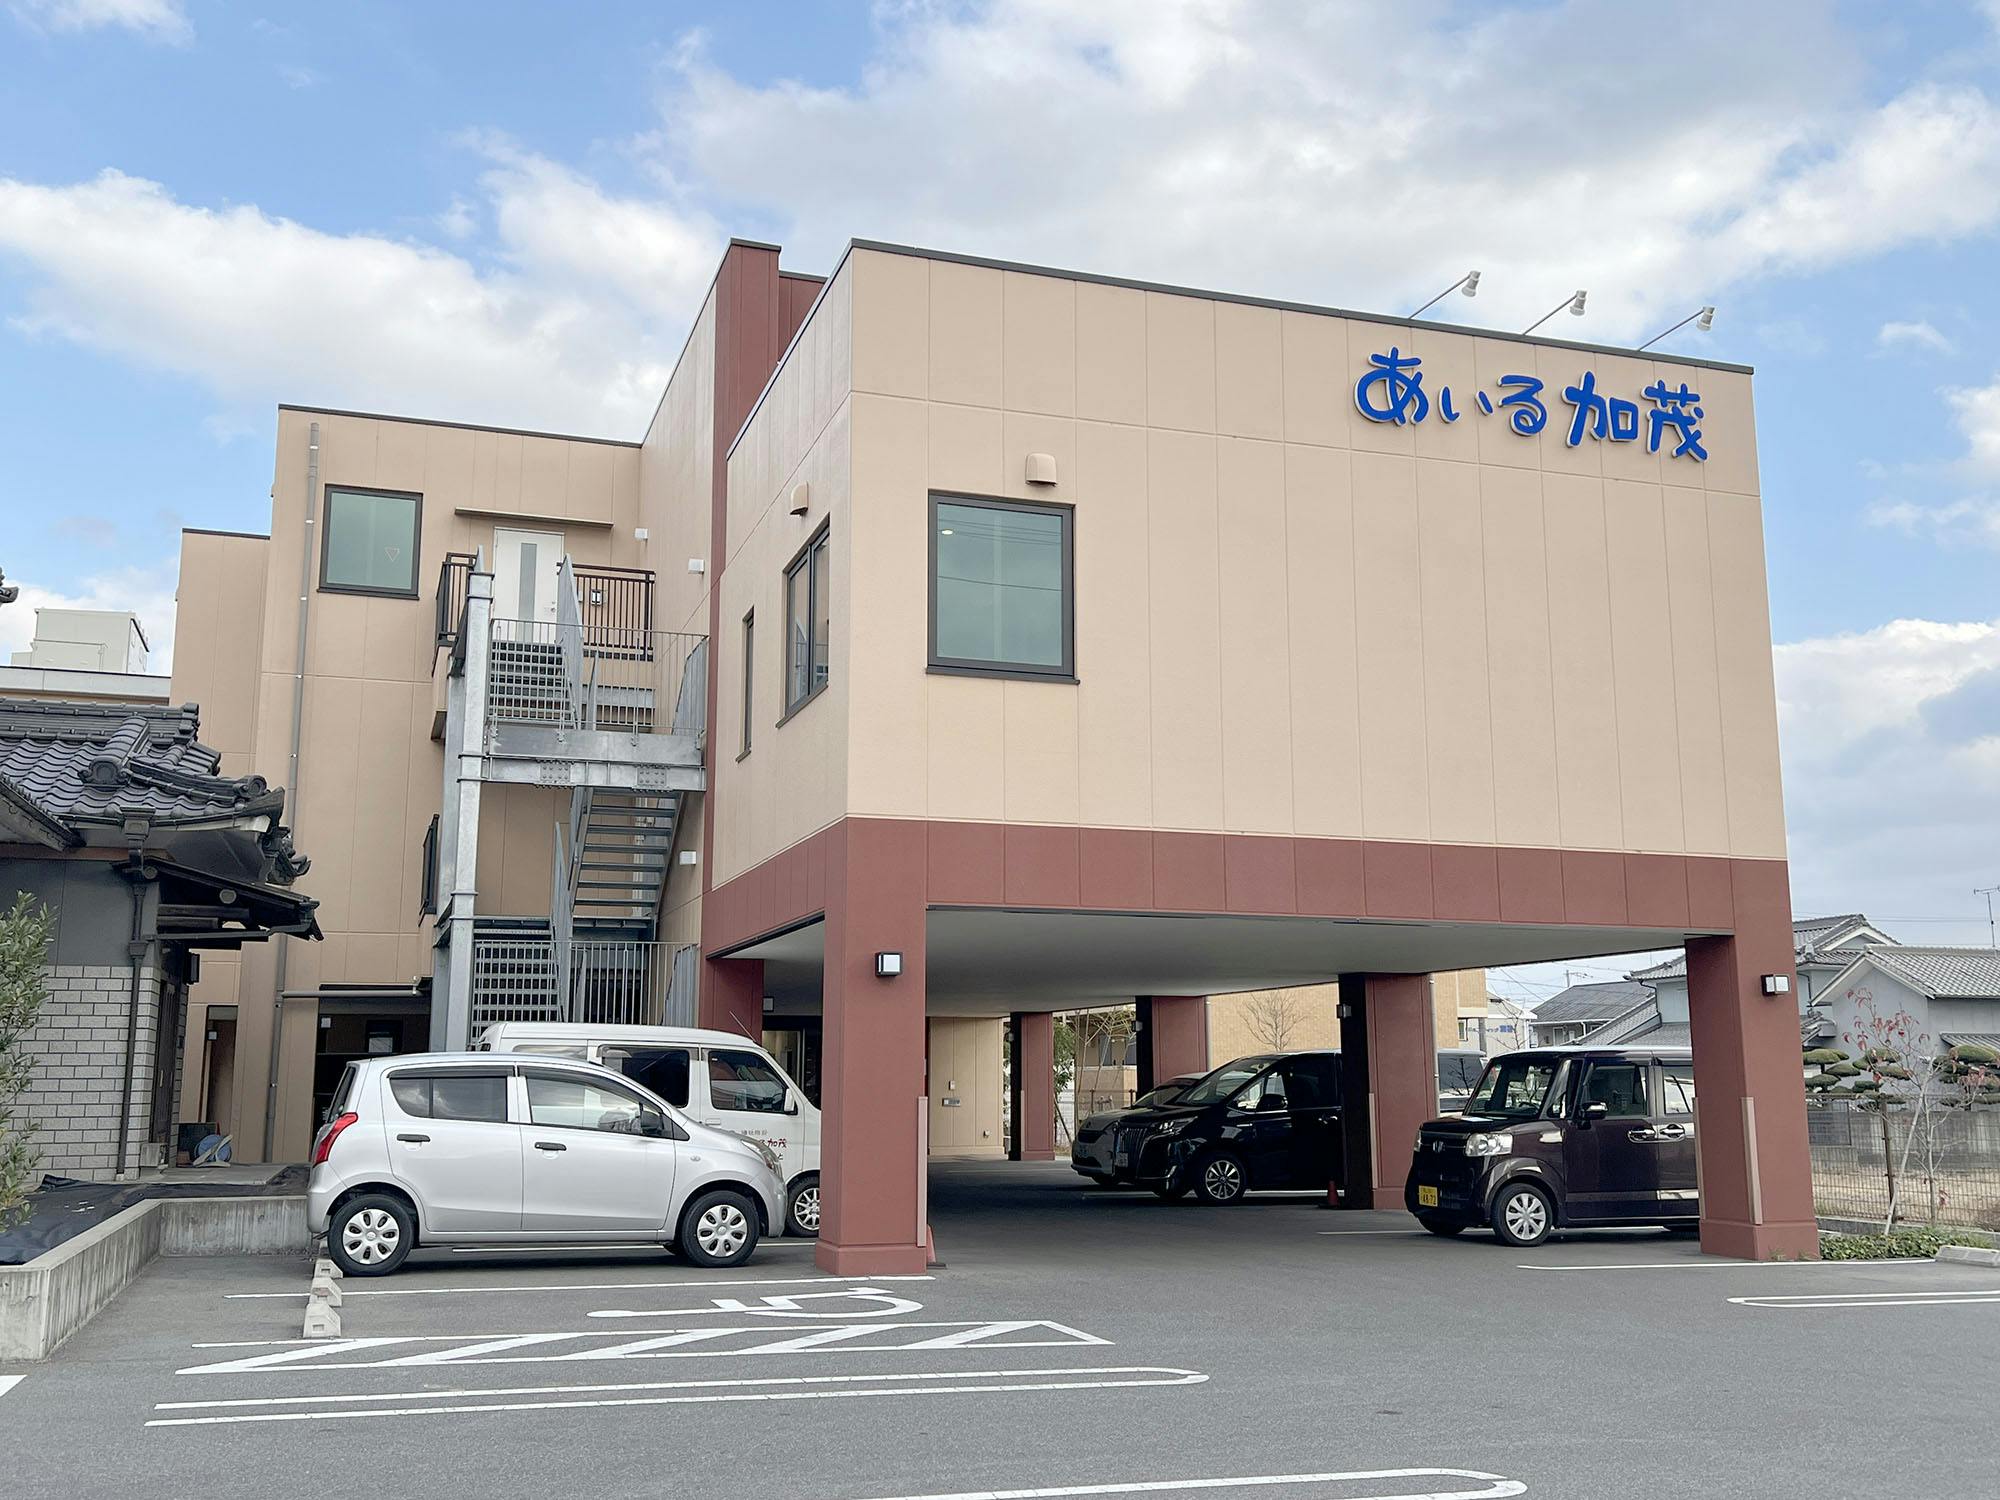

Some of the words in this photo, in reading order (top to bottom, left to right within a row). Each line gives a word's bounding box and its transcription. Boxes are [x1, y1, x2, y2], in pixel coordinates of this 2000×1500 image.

[1355, 347, 1710, 461] あいる加茂
